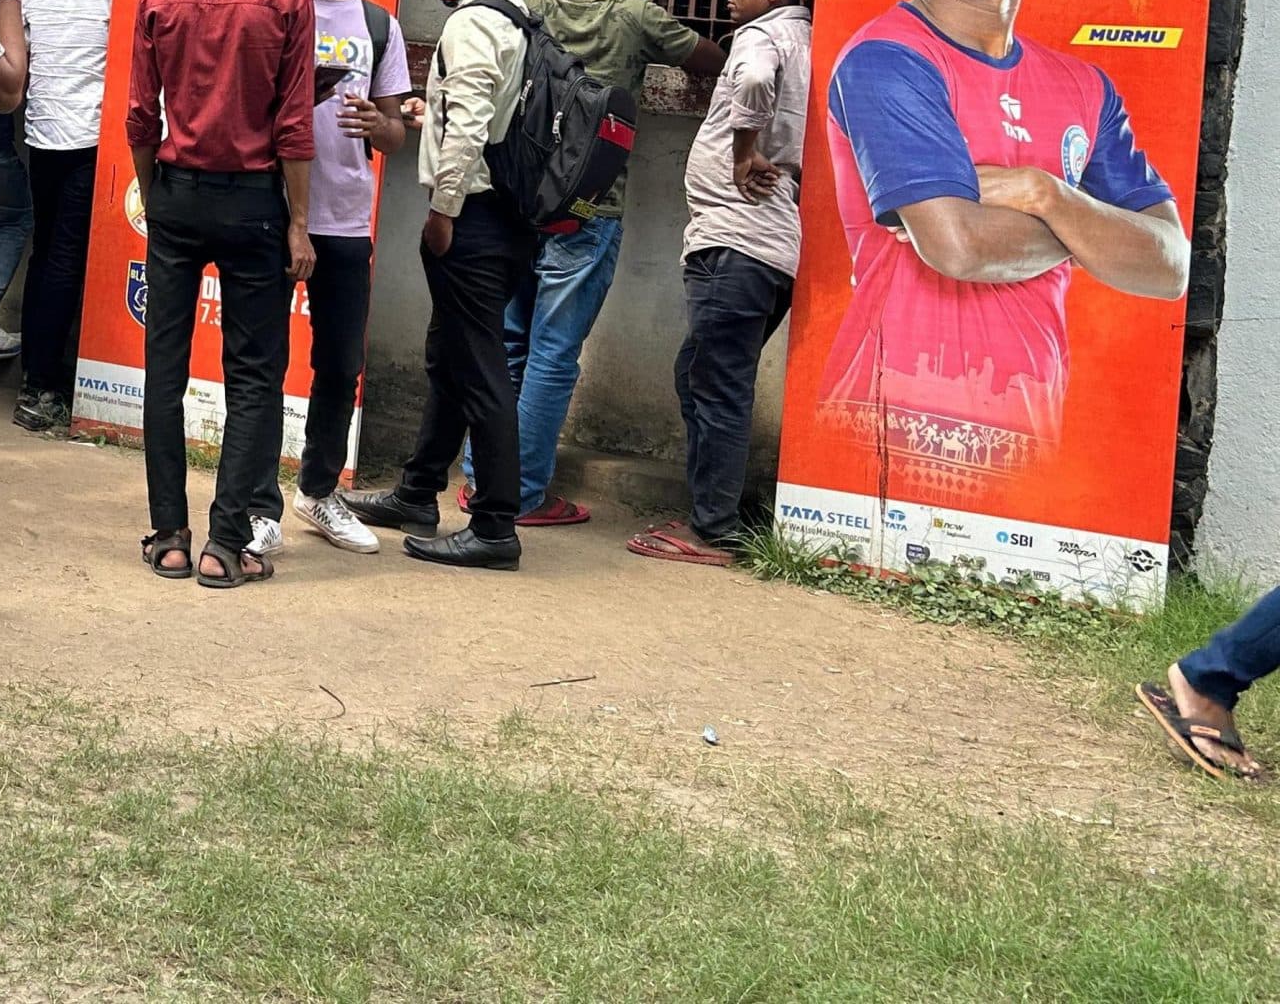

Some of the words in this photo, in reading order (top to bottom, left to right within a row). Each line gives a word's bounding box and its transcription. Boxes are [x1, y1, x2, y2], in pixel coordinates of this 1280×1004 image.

[1088, 28, 1166, 44] MURMU
[77, 376, 109, 392] TATA
[111, 382, 144, 398] STEEL
[780, 504, 824, 522] TATA
[827, 511, 872, 530] STEEL
[884, 521, 908, 532] TATA
[1010, 533, 1034, 548] SBI
[1057, 540, 1080, 550] TATA
